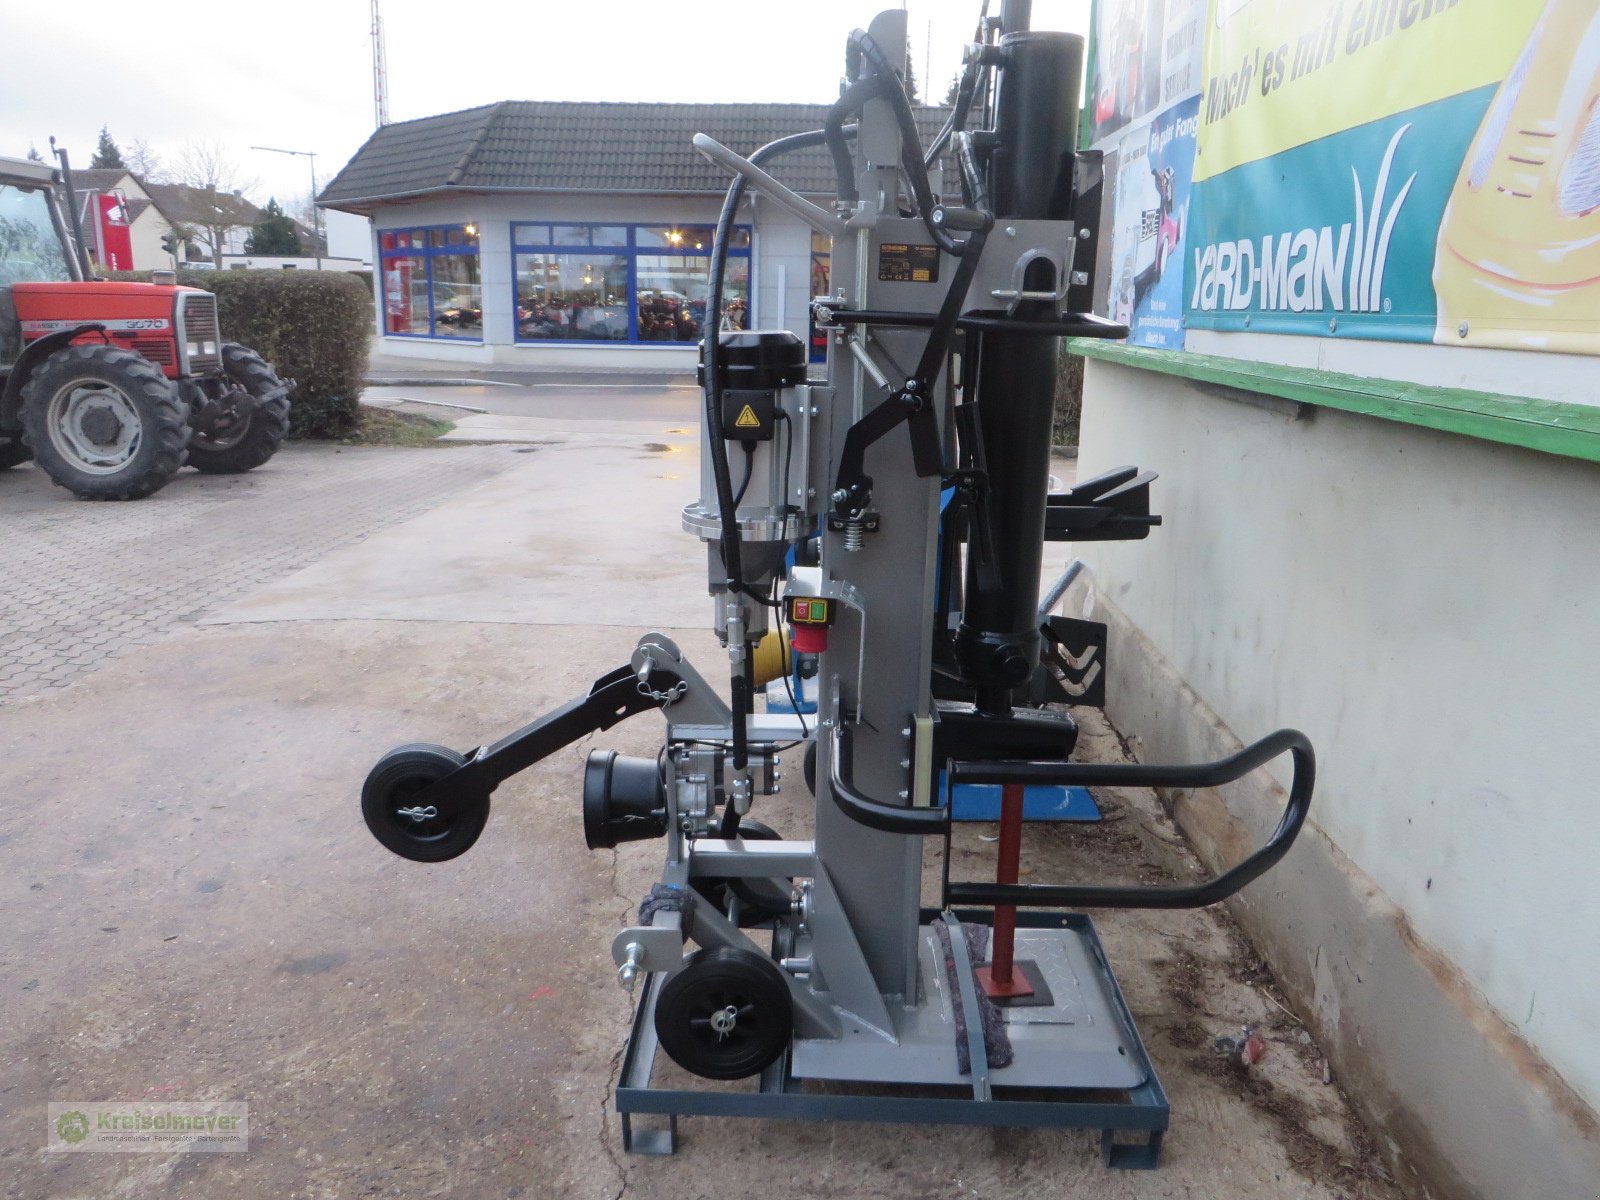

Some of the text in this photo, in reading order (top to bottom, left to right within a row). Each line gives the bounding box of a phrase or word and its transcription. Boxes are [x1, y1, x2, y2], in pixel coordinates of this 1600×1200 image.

[1261, 42, 1289, 97] es
[1289, 0, 1345, 82] mit
[1175, 114, 1200, 138] Fang
[126, 319, 163, 329] 3070
